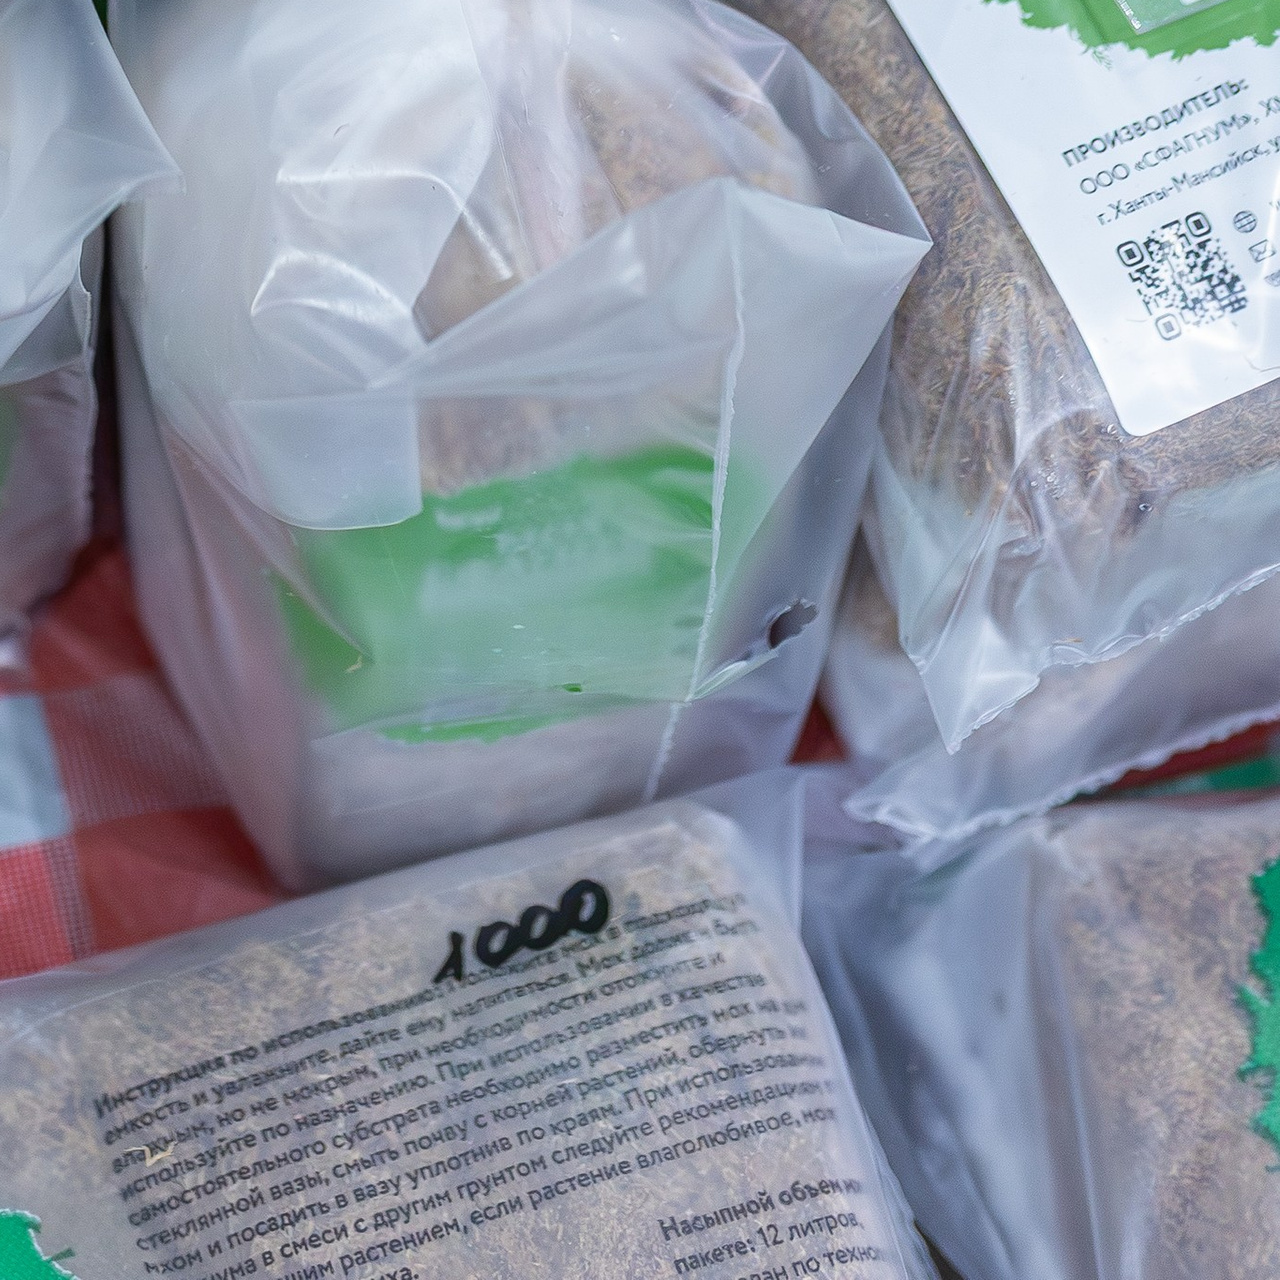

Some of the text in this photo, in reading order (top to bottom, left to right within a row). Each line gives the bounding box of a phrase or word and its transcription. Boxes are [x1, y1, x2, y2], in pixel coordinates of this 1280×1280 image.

[1061, 77, 1250, 168] ПРОИЗВОДИТЕЛЬ:
[1079, 163, 1131, 195] ООО
[431, 879, 610, 983] 1000
[93, 1054, 226, 1119] Инструкция
[230, 1044, 259, 1066] по
[192, 1091, 208, 1106] и
[339, 1028, 401, 1058] дайте
[574, 953, 623, 978] Мох
[120, 1133, 258, 1202] используйте
[261, 1122, 291, 1144] по
[293, 1074, 436, 1131] назначению.
[436, 1060, 485, 1083] При
[487, 999, 658, 1068] использовании
[660, 992, 675, 1008] в
[128, 1140, 327, 1228] самостоятельного
[331, 1100, 441, 1152] субстрата
[445, 1056, 581, 1109] необходимо
[585, 1013, 709, 1068] разместить
[136, 1185, 265, 1252] стеклянной
[269, 1171, 331, 1202] вазы,
[331, 1146, 400, 1180] смыть
[403, 1120, 470, 1157] почву
[473, 1112, 489, 1130] с
[490, 1082, 573, 1123] корней
[576, 1048, 688, 1100] растений,
[688, 1024, 786, 1058] обернуть
[216, 1107, 246, 1129] но
[249, 1096, 279, 1117] не
[378, 1048, 422, 1073] при
[144, 1249, 204, 1276] мхом
[207, 1241, 224, 1258] и
[226, 1202, 331, 1251] посадить
[334, 1193, 350, 1210] в
[352, 1174, 402, 1204] вазу
[404, 1135, 513, 1192] уплотнив
[516, 1126, 547, 1147] по
[549, 1101, 623, 1137] краям.
[622, 1086, 676, 1112] При
[261, 1250, 276, 1268] в
[279, 1225, 350, 1259] смеси
[353, 1217, 368, 1234] с
[372, 1189, 454, 1232] другим
[457, 1155, 548, 1202] грунтом
[550, 1120, 655, 1165] следуйте
[338, 1217, 470, 1277] растением,
[469, 1196, 525, 1227] если
[527, 1158, 634, 1211] растение
[636, 1108, 803, 1171] влаголюбивое,
[656, 1190, 776, 1242] Насыпной
[778, 1179, 840, 1208] объем
[673, 1211, 865, 1275] пакете: 12 литров,
[791, 1255, 821, 1277] по
